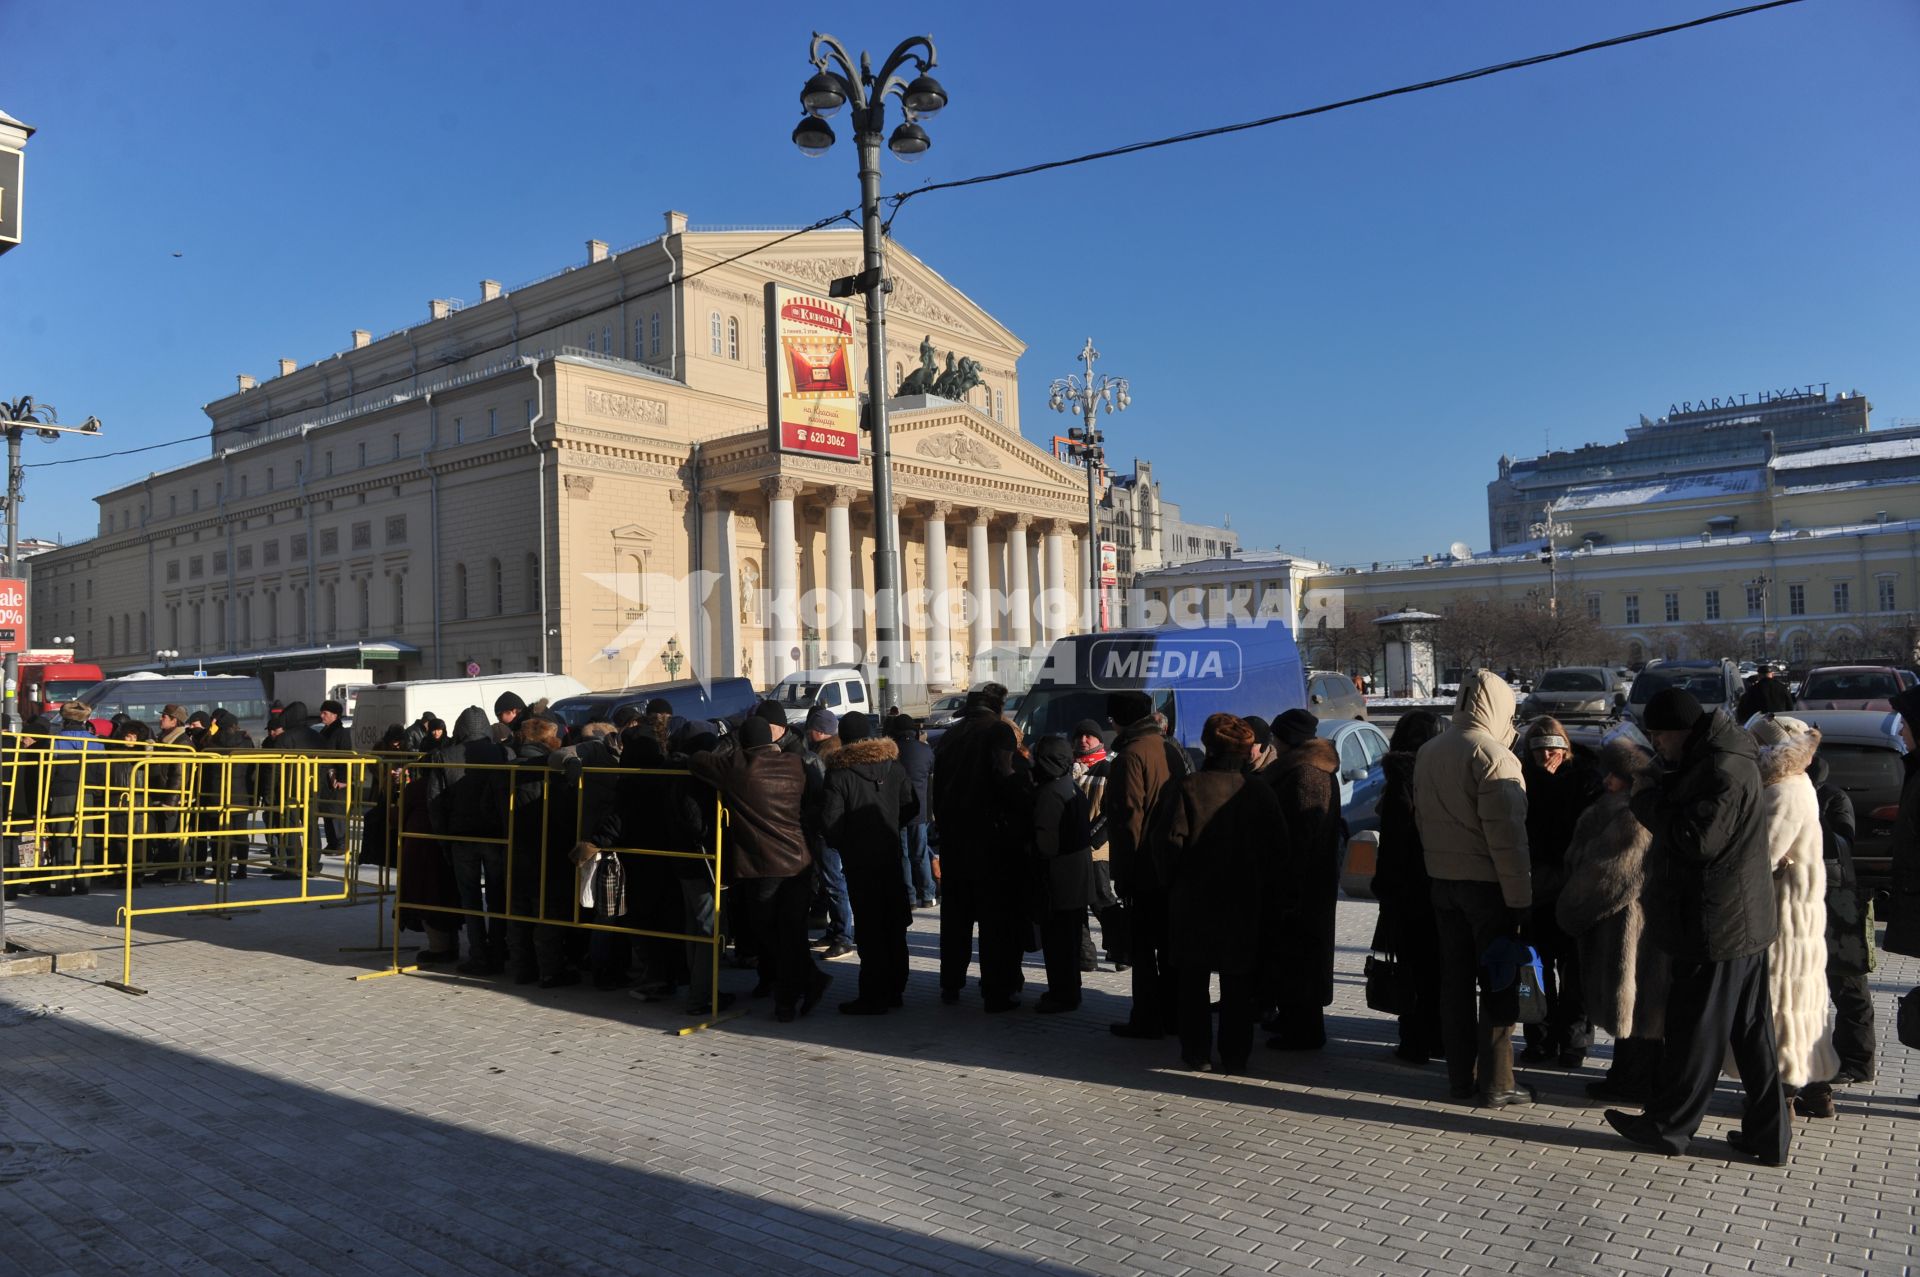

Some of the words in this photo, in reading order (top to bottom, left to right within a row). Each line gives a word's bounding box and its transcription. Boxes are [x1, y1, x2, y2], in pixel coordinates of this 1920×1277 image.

[1669, 393, 1749, 416] ARARAT
[1758, 382, 1830, 405] HYATT
[810, 431, 825, 444] 620
[826, 434, 846, 447] 3062
